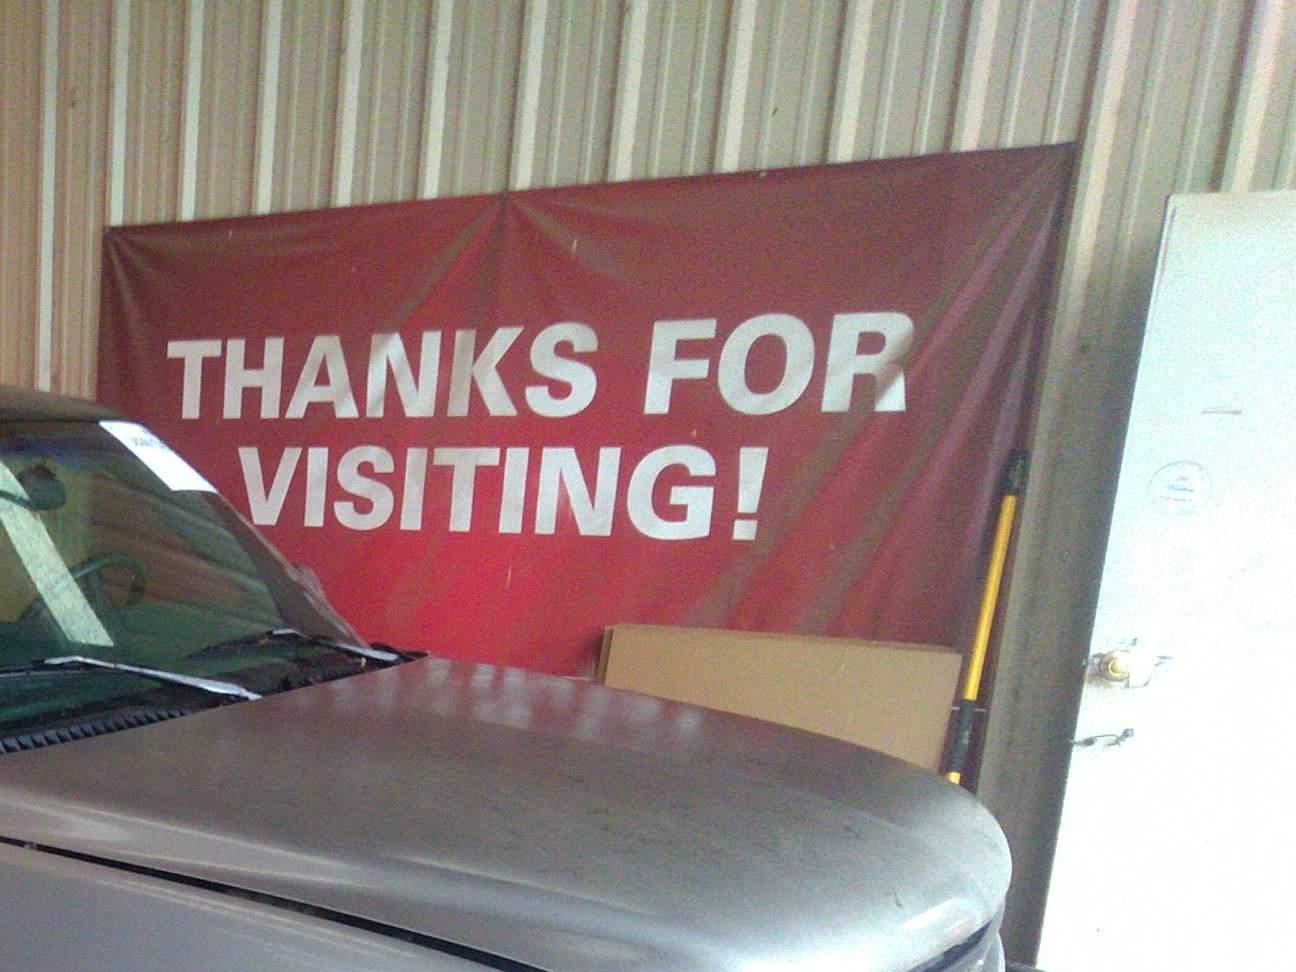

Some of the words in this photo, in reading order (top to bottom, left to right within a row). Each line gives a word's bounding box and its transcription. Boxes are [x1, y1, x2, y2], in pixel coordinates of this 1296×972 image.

[166, 320, 599, 419] THANKS
[643, 311, 914, 416] FOR
[238, 444, 769, 541] VISITING!
